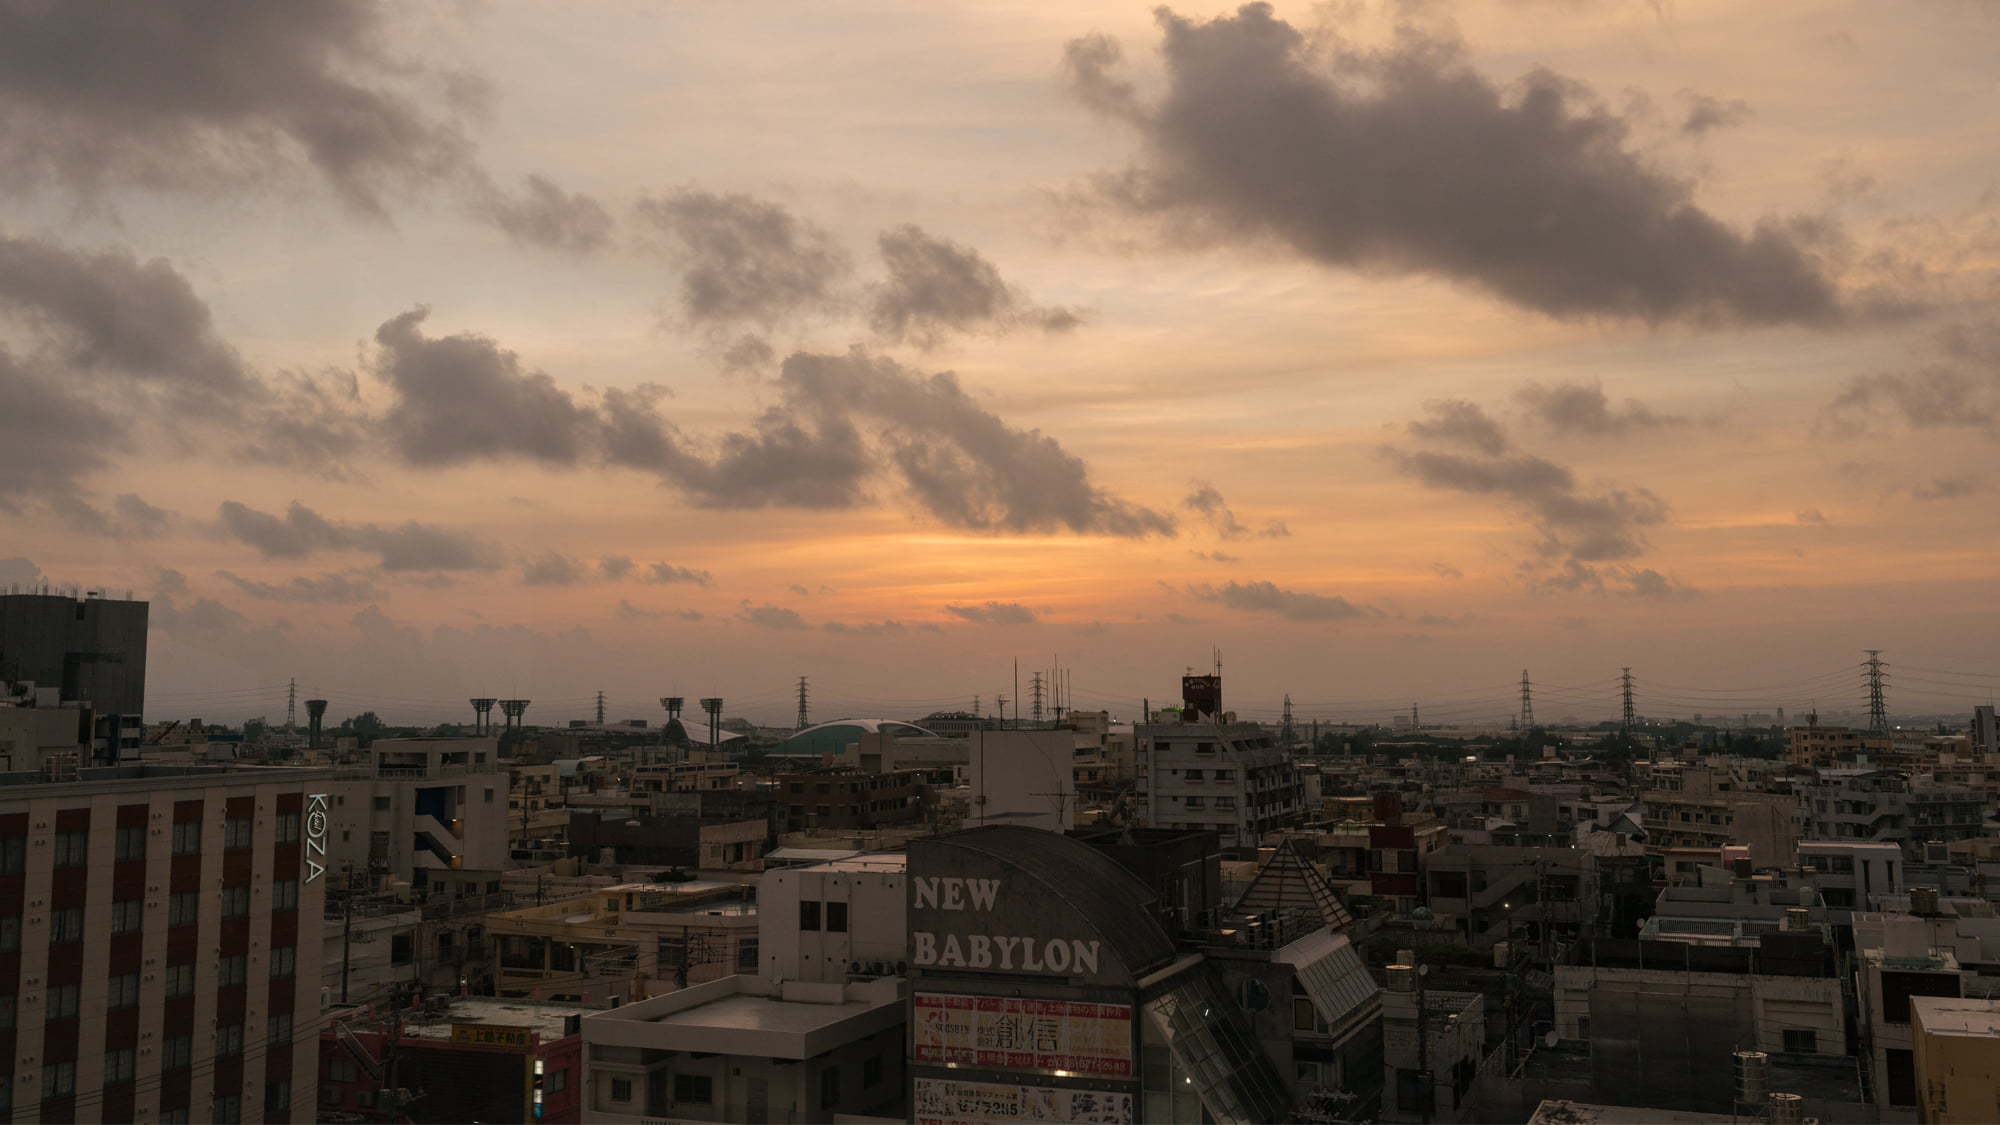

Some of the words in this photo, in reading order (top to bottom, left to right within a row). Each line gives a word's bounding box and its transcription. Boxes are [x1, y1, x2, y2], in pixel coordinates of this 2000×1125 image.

[304, 793, 328, 883] KOZA
[913, 876, 1000, 911] NEW
[913, 932, 1100, 974] BABYLON
